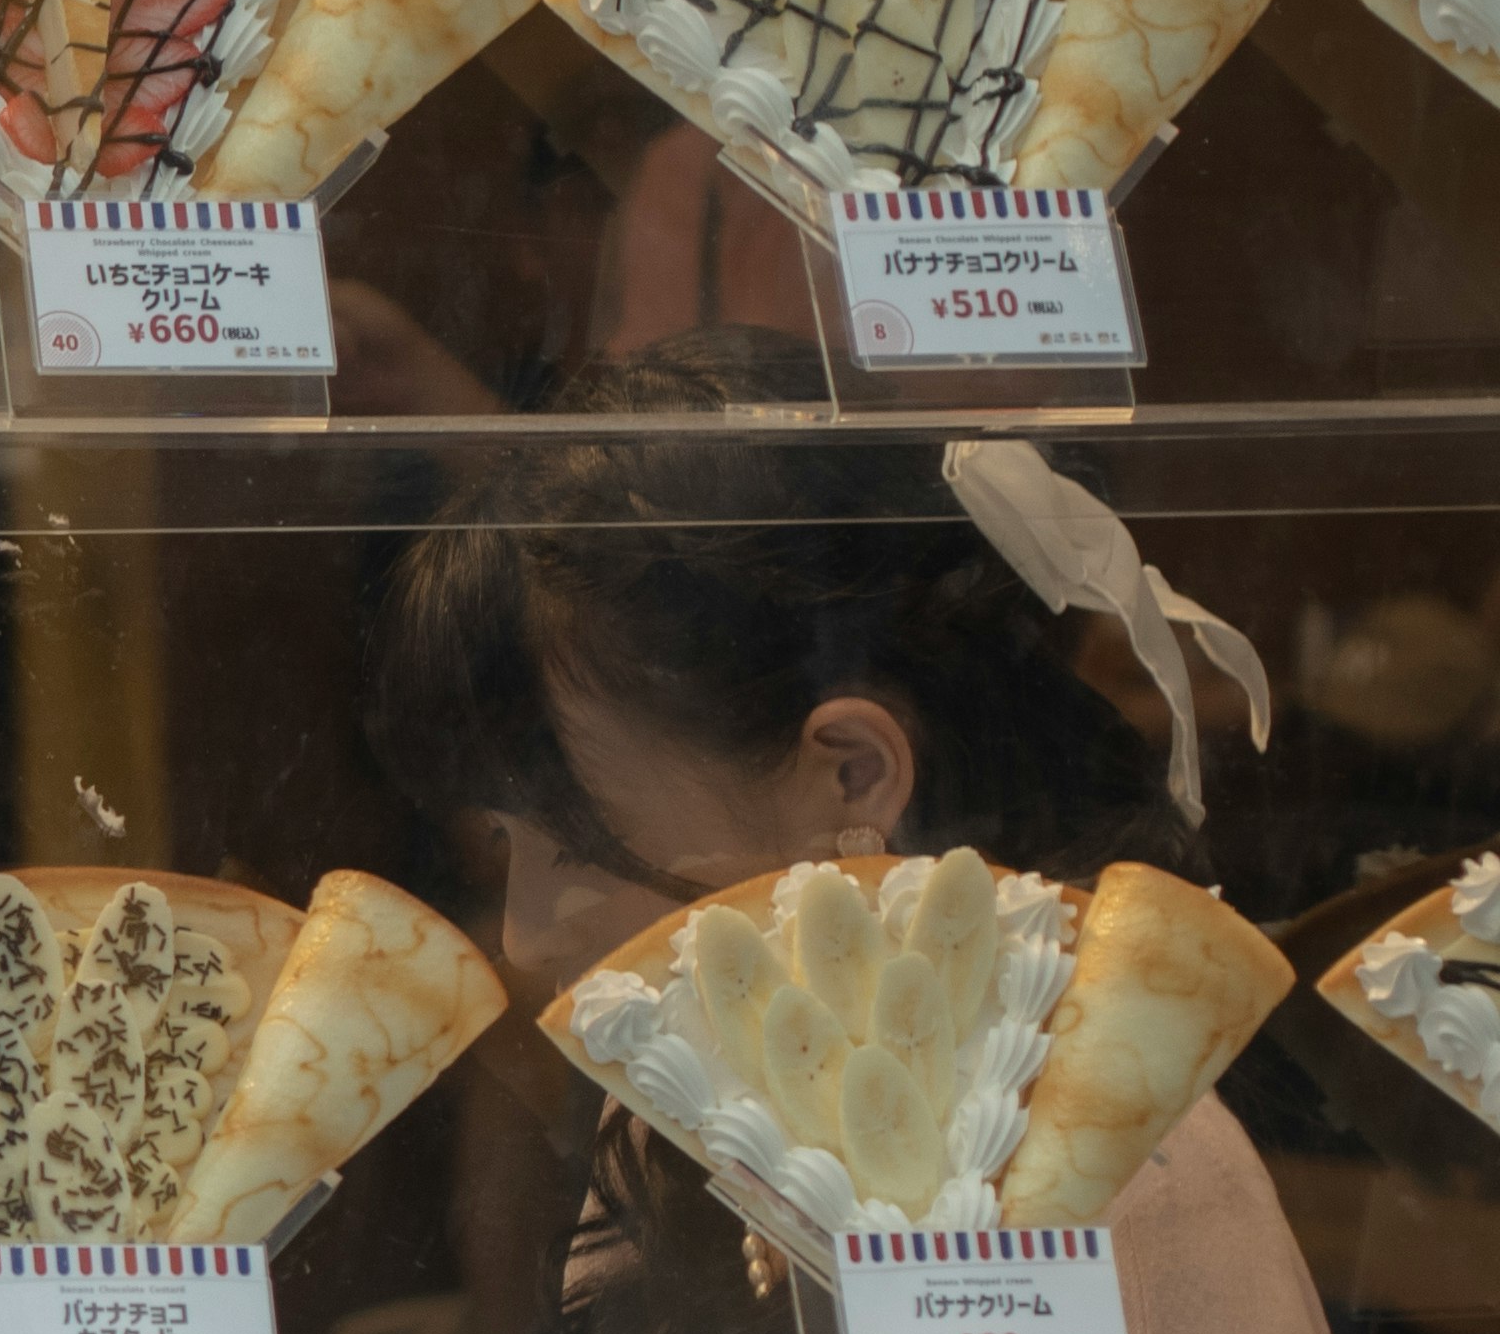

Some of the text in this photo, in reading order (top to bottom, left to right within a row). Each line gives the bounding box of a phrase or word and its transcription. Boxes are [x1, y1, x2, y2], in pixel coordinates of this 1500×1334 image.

[86, 263, 270, 286] いちごチョコケーキ
[885, 251, 1078, 275] バナナチョコクリーム
[141, 290, 220, 311] クリーム
[932, 288, 1018, 319] ¥510
[129, 315, 218, 344] ¥660
[875, 324, 886, 340] 8
[52, 334, 78, 351] 40
[64, 1301, 188, 1325] バナナチョコ
[916, 1293, 1052, 1318] バナナクリーム
